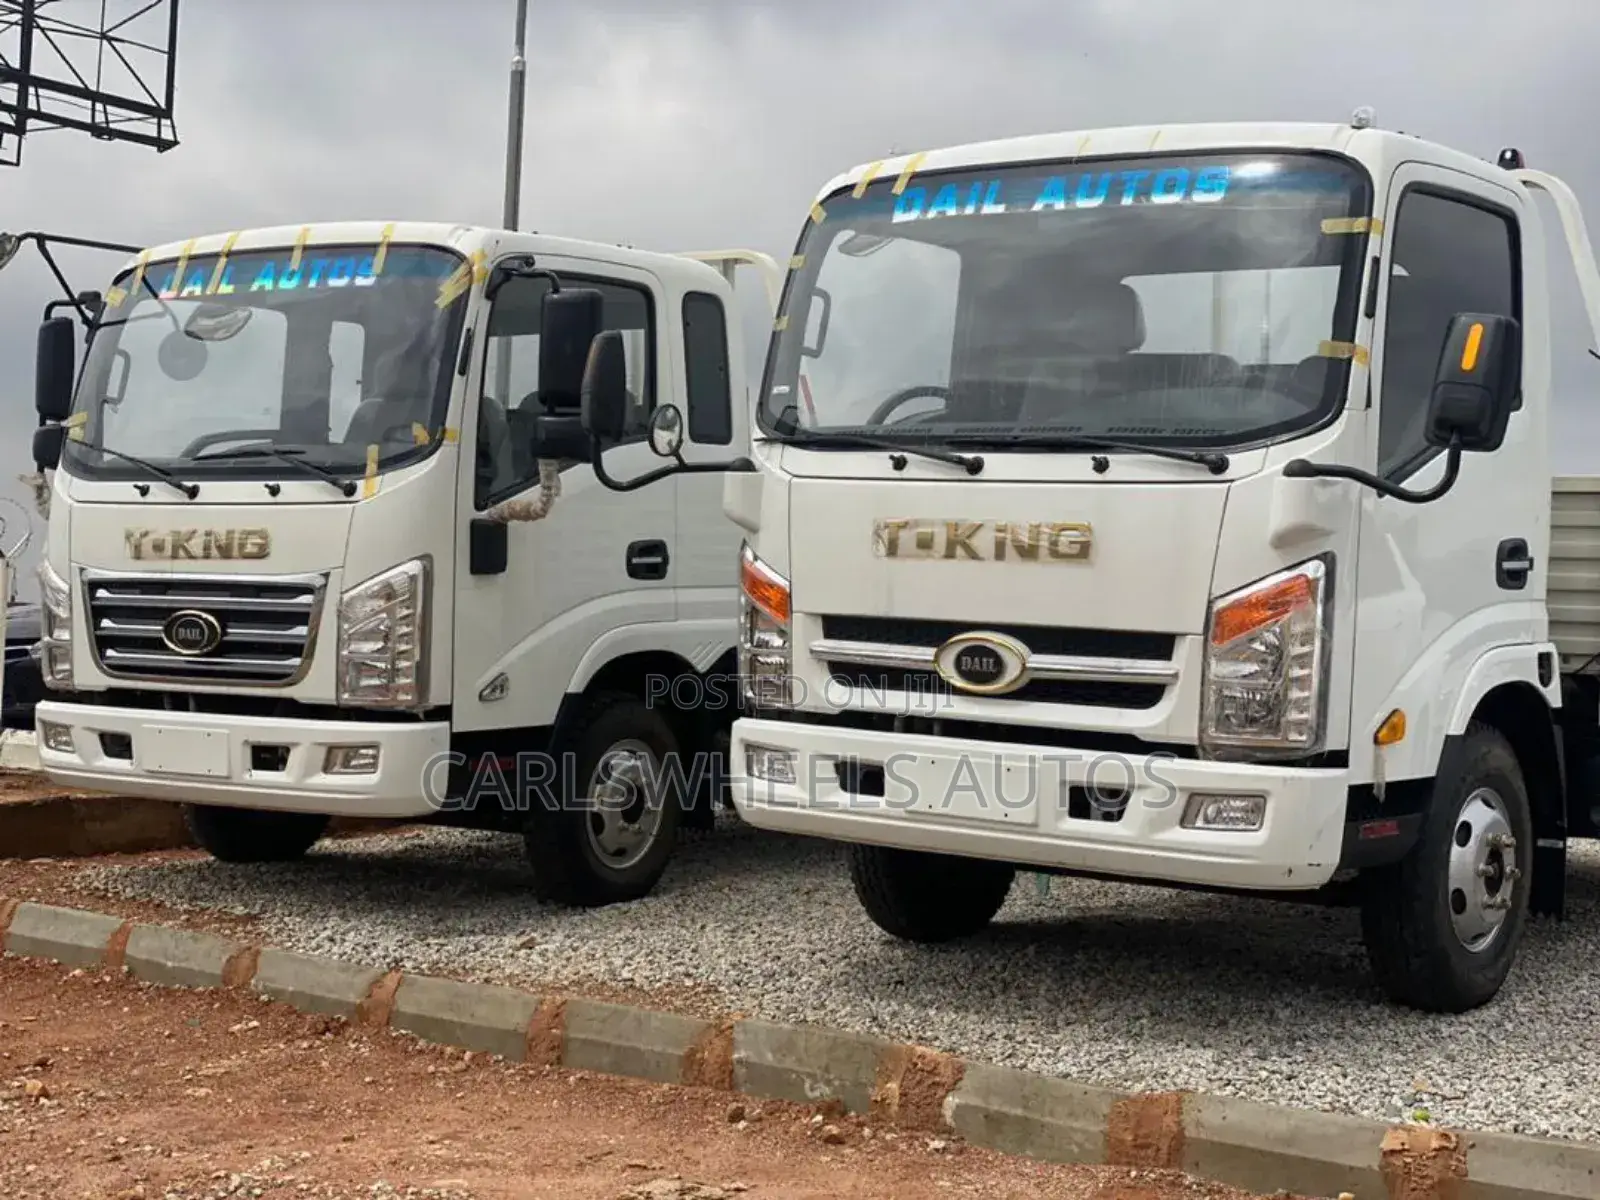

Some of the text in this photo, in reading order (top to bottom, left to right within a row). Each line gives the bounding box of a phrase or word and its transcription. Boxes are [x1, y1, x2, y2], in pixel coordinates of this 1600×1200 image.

[892, 165, 1230, 223] DAIL AUTOS
[178, 627, 202, 640] DAIL
[960, 655, 997, 673] DAIL
